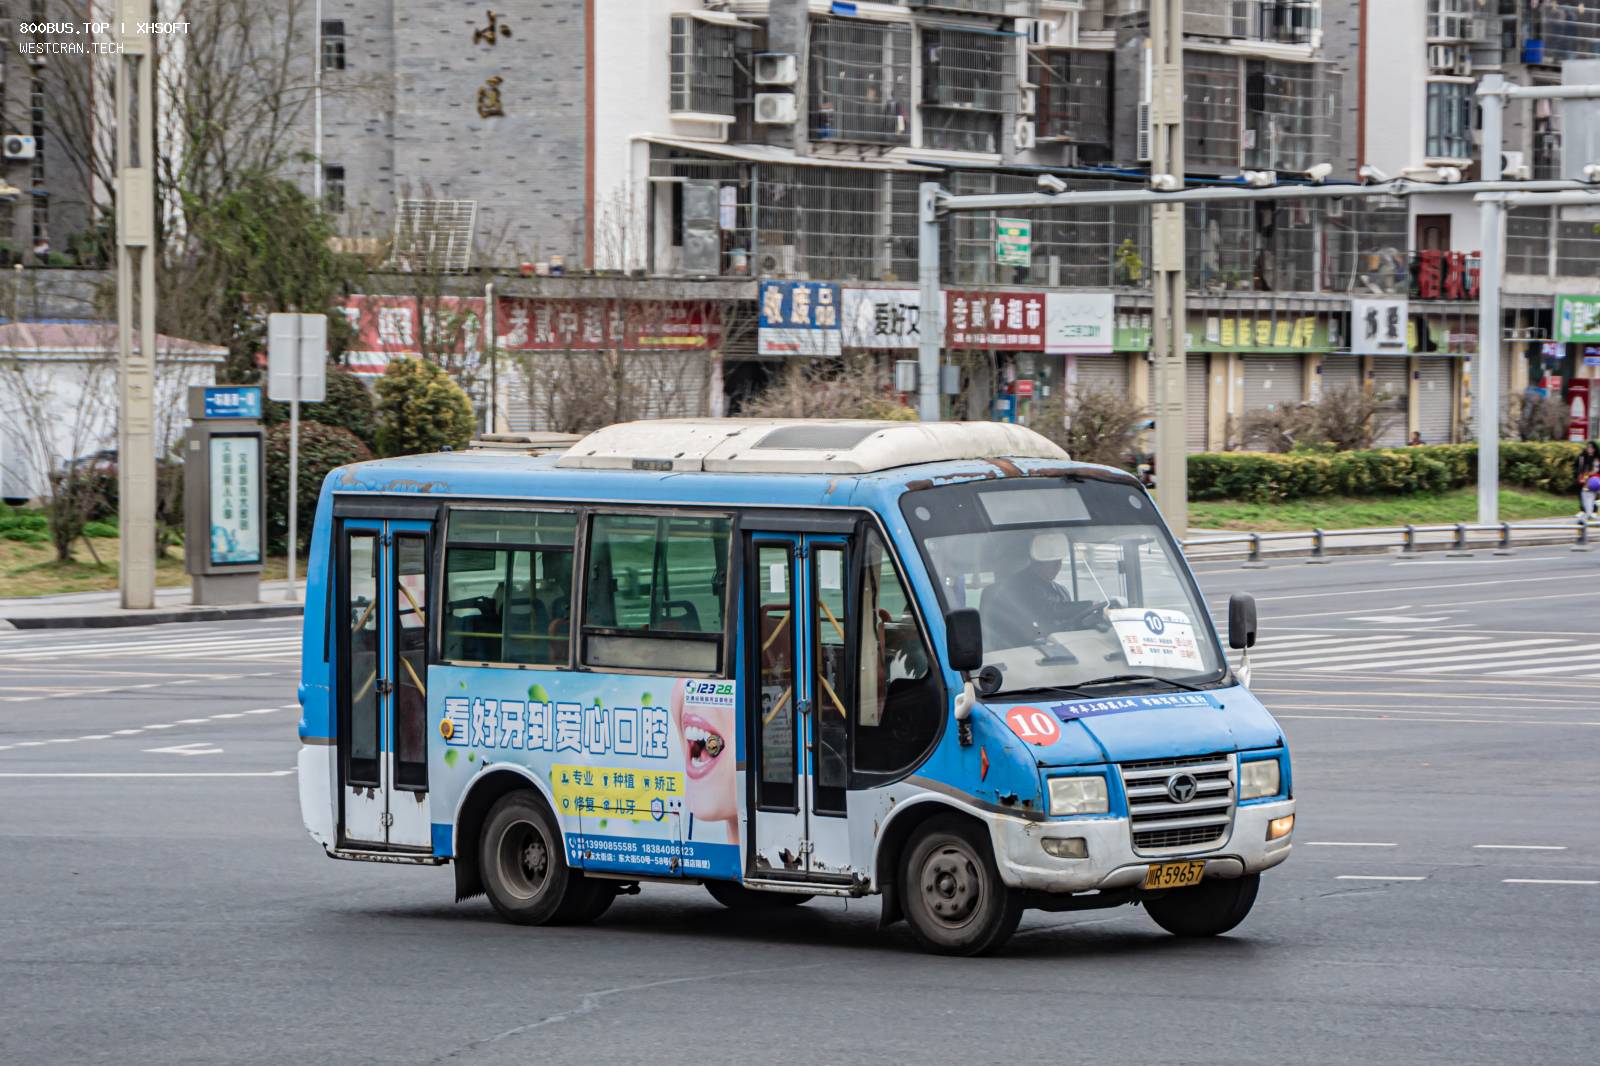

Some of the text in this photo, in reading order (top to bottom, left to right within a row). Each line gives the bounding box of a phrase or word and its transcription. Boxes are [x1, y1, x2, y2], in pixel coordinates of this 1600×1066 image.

[1145, 615, 1162, 631] 10
[696, 683, 733, 695] 12328
[443, 697, 669, 758] 看好牙到爱心口腔
[1012, 712, 1055, 737] 10
[573, 769, 676, 792] 专业 种植 矫正
[575, 796, 636, 815] 修复 儿牙
